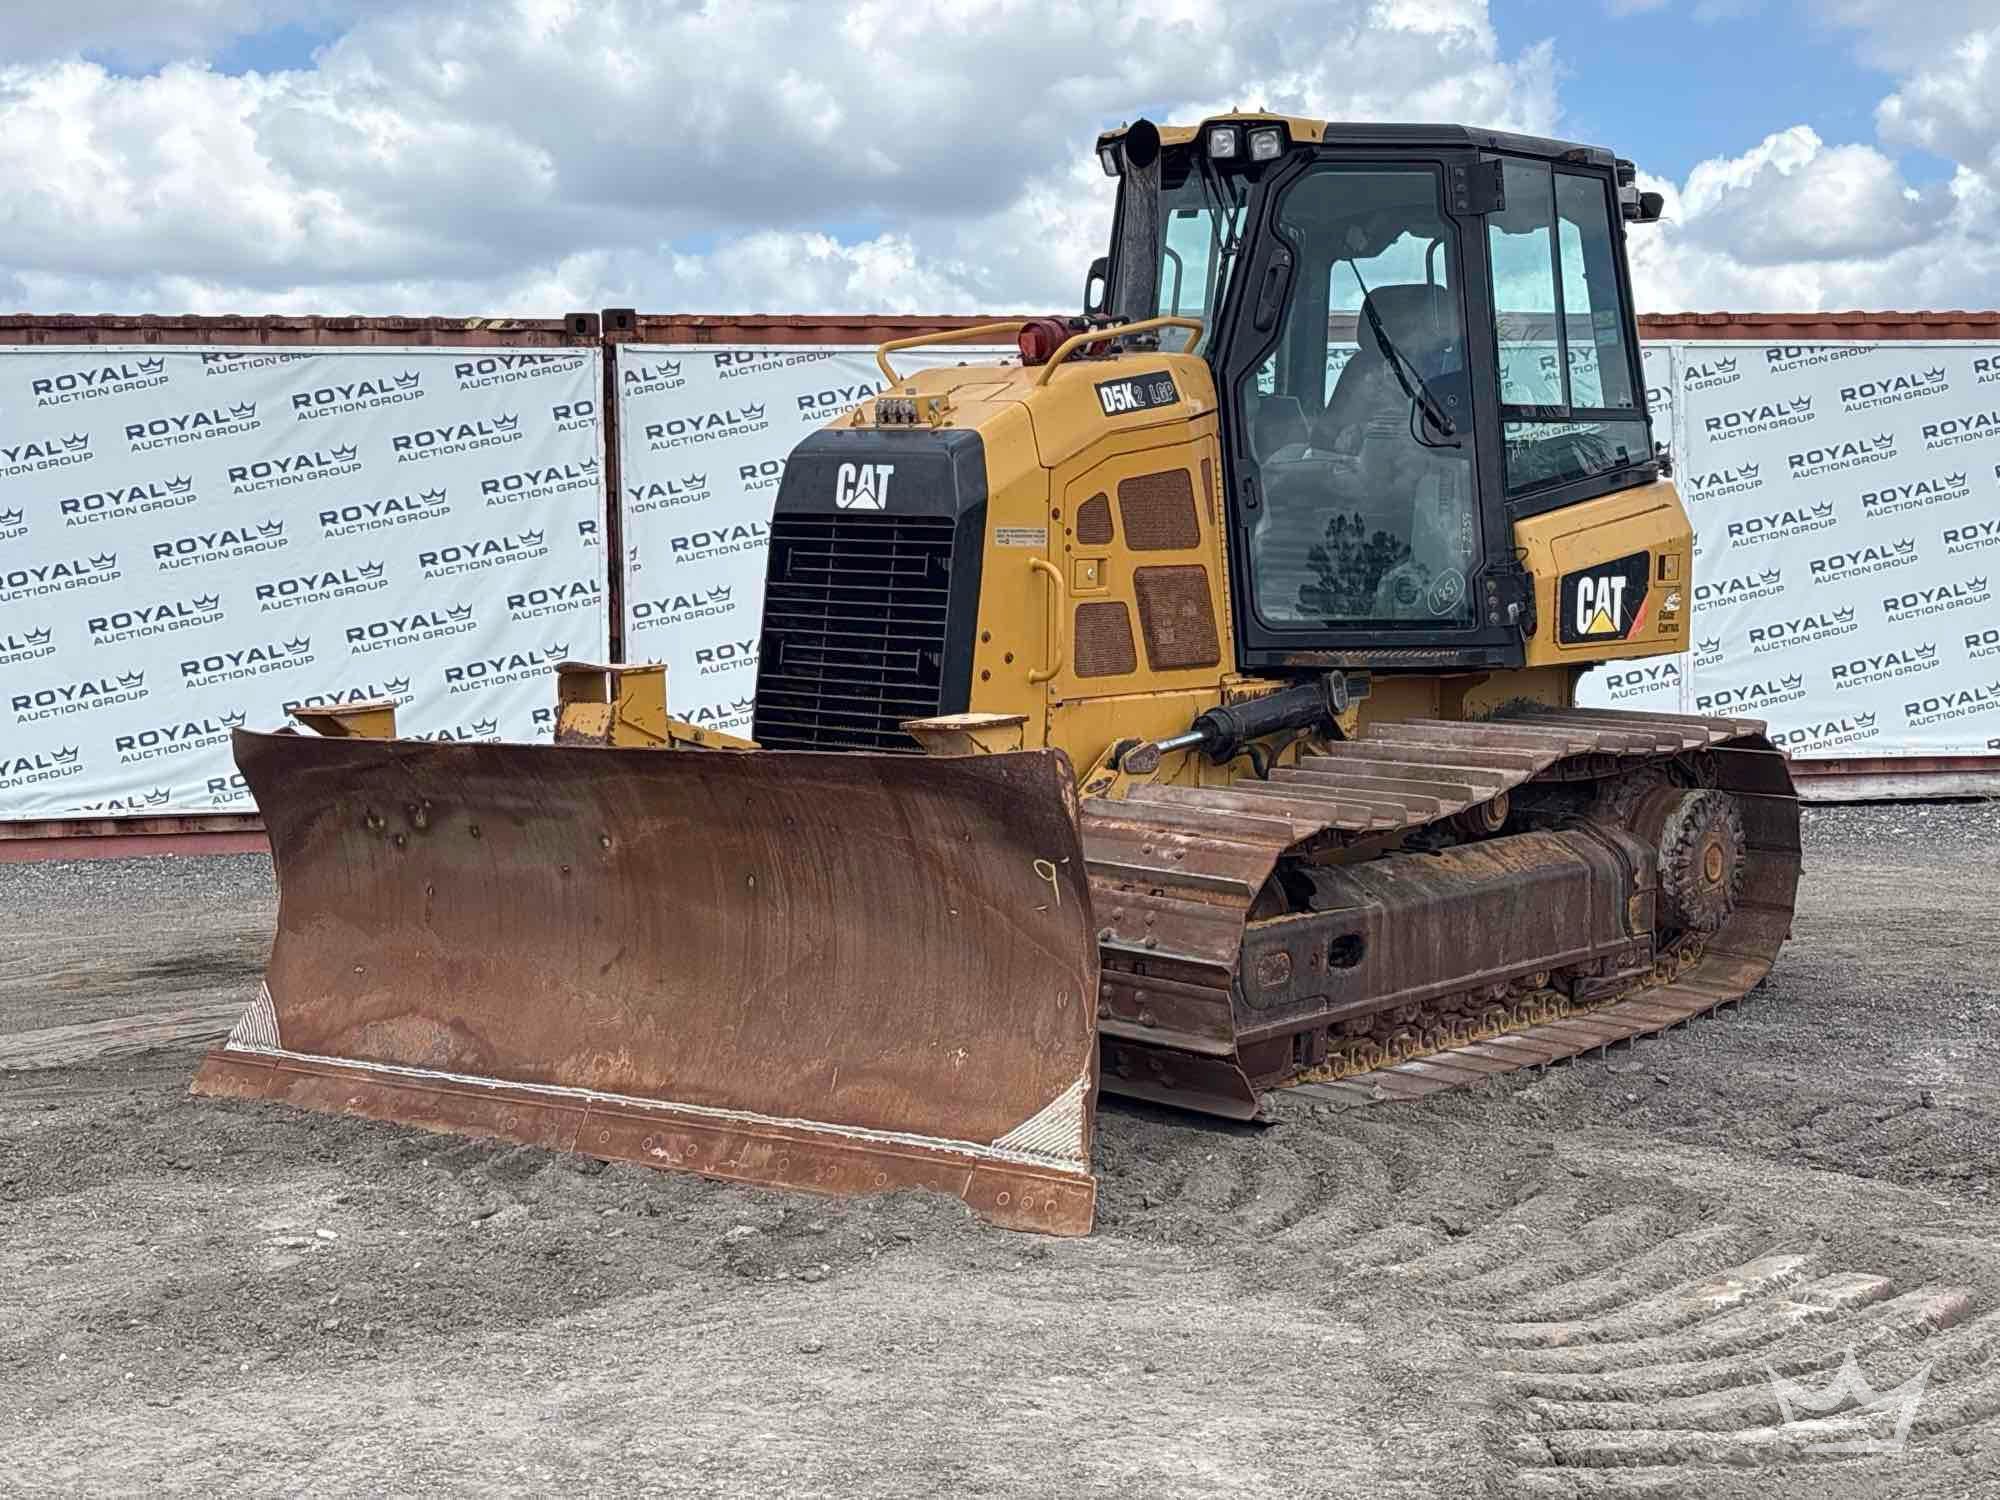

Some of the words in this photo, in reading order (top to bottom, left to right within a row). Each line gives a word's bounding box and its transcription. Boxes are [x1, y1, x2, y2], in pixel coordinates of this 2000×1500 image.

[206, 356, 277, 376] AUCTION
[460, 371, 528, 390] AUCTION
[530, 360, 584, 377] GROUP
[719, 360, 784, 379] AUCTION
[1771, 355, 1828, 373] AUCTION
[32, 364, 139, 395] ROYAL
[38, 386, 109, 407] AUCTION
[113, 376, 168, 393] GROUP
[634, 379, 685, 395] GROUP
[1695, 374, 1740, 390] GROUP
[1840, 374, 1925, 402] ROYAL
[292, 379, 395, 410] ROYAL
[298, 400, 367, 421] AUCTION
[369, 390, 424, 407] GROUP
[1845, 393, 1902, 412] AUCTION
[1904, 384, 1949, 400] GROUP
[125, 409, 231, 440] ROYAL
[645, 410, 741, 440] ROYAL
[1705, 403, 1790, 432] ROYAL
[1710, 423, 1767, 442] AUCTION
[1769, 413, 1815, 429] GROUP
[131, 431, 202, 452] AUCTION
[205, 421, 261, 438] GROUP
[392, 421, 493, 452] ROYAL
[398, 443, 466, 463] AUCTION
[469, 432, 522, 449] GROUP
[651, 432, 715, 451] AUCTION
[718, 422, 768, 437] GROUP
[1927, 431, 1982, 450] AUCTION
[0, 441, 63, 463] YAL
[37, 452, 93, 470] GROUP
[1788, 440, 1873, 469] ROYAL
[1793, 460, 1850, 478] AUCTION
[1852, 450, 1896, 466] GROUP
[228, 452, 332, 483] ROYAL
[234, 474, 304, 494] AUCTION
[307, 463, 361, 480] GROUP
[481, 465, 581, 495] ROYAL
[1691, 470, 1738, 489] YAL
[60, 484, 166, 515] ROYAL
[487, 486, 553, 506] AUCTION
[556, 476, 600, 492] GROU
[628, 481, 683, 501] YAL
[659, 492, 710, 508] GROUP
[835, 463, 894, 510] CAT
[1717, 480, 1762, 495] GROUP
[1862, 479, 1946, 507] ROYAL
[67, 505, 137, 527] AUCTION
[140, 495, 197, 512] GROUP
[319, 496, 421, 527] ROYAL
[1867, 499, 1923, 517] AUCTION
[1925, 489, 1969, 504] GROUP
[325, 518, 393, 538] AUCTION
[396, 507, 450, 524] GROUP
[1728, 509, 1812, 538] ROYAL
[1732, 528, 1789, 548] AUCTION
[1791, 519, 1836, 534] GROUP
[153, 528, 258, 559] ROYAL
[671, 523, 766, 552] ROYAL
[159, 549, 229, 570] AUCTION
[232, 539, 288, 556] GROUP
[419, 537, 520, 568] ROYAL
[425, 559, 492, 579] AUCTION
[495, 548, 548, 565] GROUP
[676, 544, 740, 563] AUCTION
[1810, 546, 1894, 574] ROYAL
[1815, 566, 1871, 584] AUCTION
[1873, 555, 1918, 571] GROUP
[0, 583, 61, 601] UCTION
[64, 572, 121, 589] GROUP
[256, 569, 359, 600] ROYAL
[261, 591, 330, 612] AUCTION
[334, 580, 388, 597] GROUP
[1695, 576, 1760, 600] OYAL
[1739, 585, 1784, 601] GROUP
[1883, 584, 1967, 612] ROYAL
[88, 602, 194, 634] ROYAL
[512, 600, 578, 621] AUCTION
[632, 593, 707, 618] OYAL
[684, 603, 735, 620] GROUP
[1577, 576, 1626, 634] CAT
[1888, 603, 1944, 622] AUCTION
[1946, 593, 1991, 609] GROUP
[94, 624, 164, 646] AUCTION
[168, 613, 224, 630] GROUP
[346, 612, 448, 643] ROYAL
[352, 633, 419, 655] AUCTION
[423, 622, 476, 639] GROUP
[1749, 614, 1834, 643] ROYAL
[1754, 634, 1810, 653] AUCTION
[1813, 624, 1858, 640] GROUP
[181, 645, 285, 677] ROYAL
[186, 667, 256, 688] AUCTION
[259, 655, 314, 673] GROUP
[445, 652, 544, 683] ROYAL
[1832, 650, 1916, 679] ROYAL
[1836, 670, 1892, 689] AUCTION
[1895, 660, 1939, 676] GROUP
[450, 673, 517, 694] AUCTION
[520, 664, 556, 679] GRO
[1606, 663, 1680, 690] ROYA
[1611, 681, 1670, 700] AUCTION
[12, 679, 118, 712] ROYAL
[17, 701, 88, 723] AUCTION
[92, 690, 148, 708] GROUP
[1696, 681, 1782, 710] ROYAL
[1760, 690, 1806, 707] GROUP
[1905, 688, 1988, 717] ROYAL
[1909, 708, 1965, 728] AUCTION
[115, 720, 221, 752] ROYAL
[121, 742, 192, 764] AUCTION
[195, 734, 231, 748] GRO
[1835, 728, 1879, 744] GROUP
[26, 765, 83, 783] GROUP
